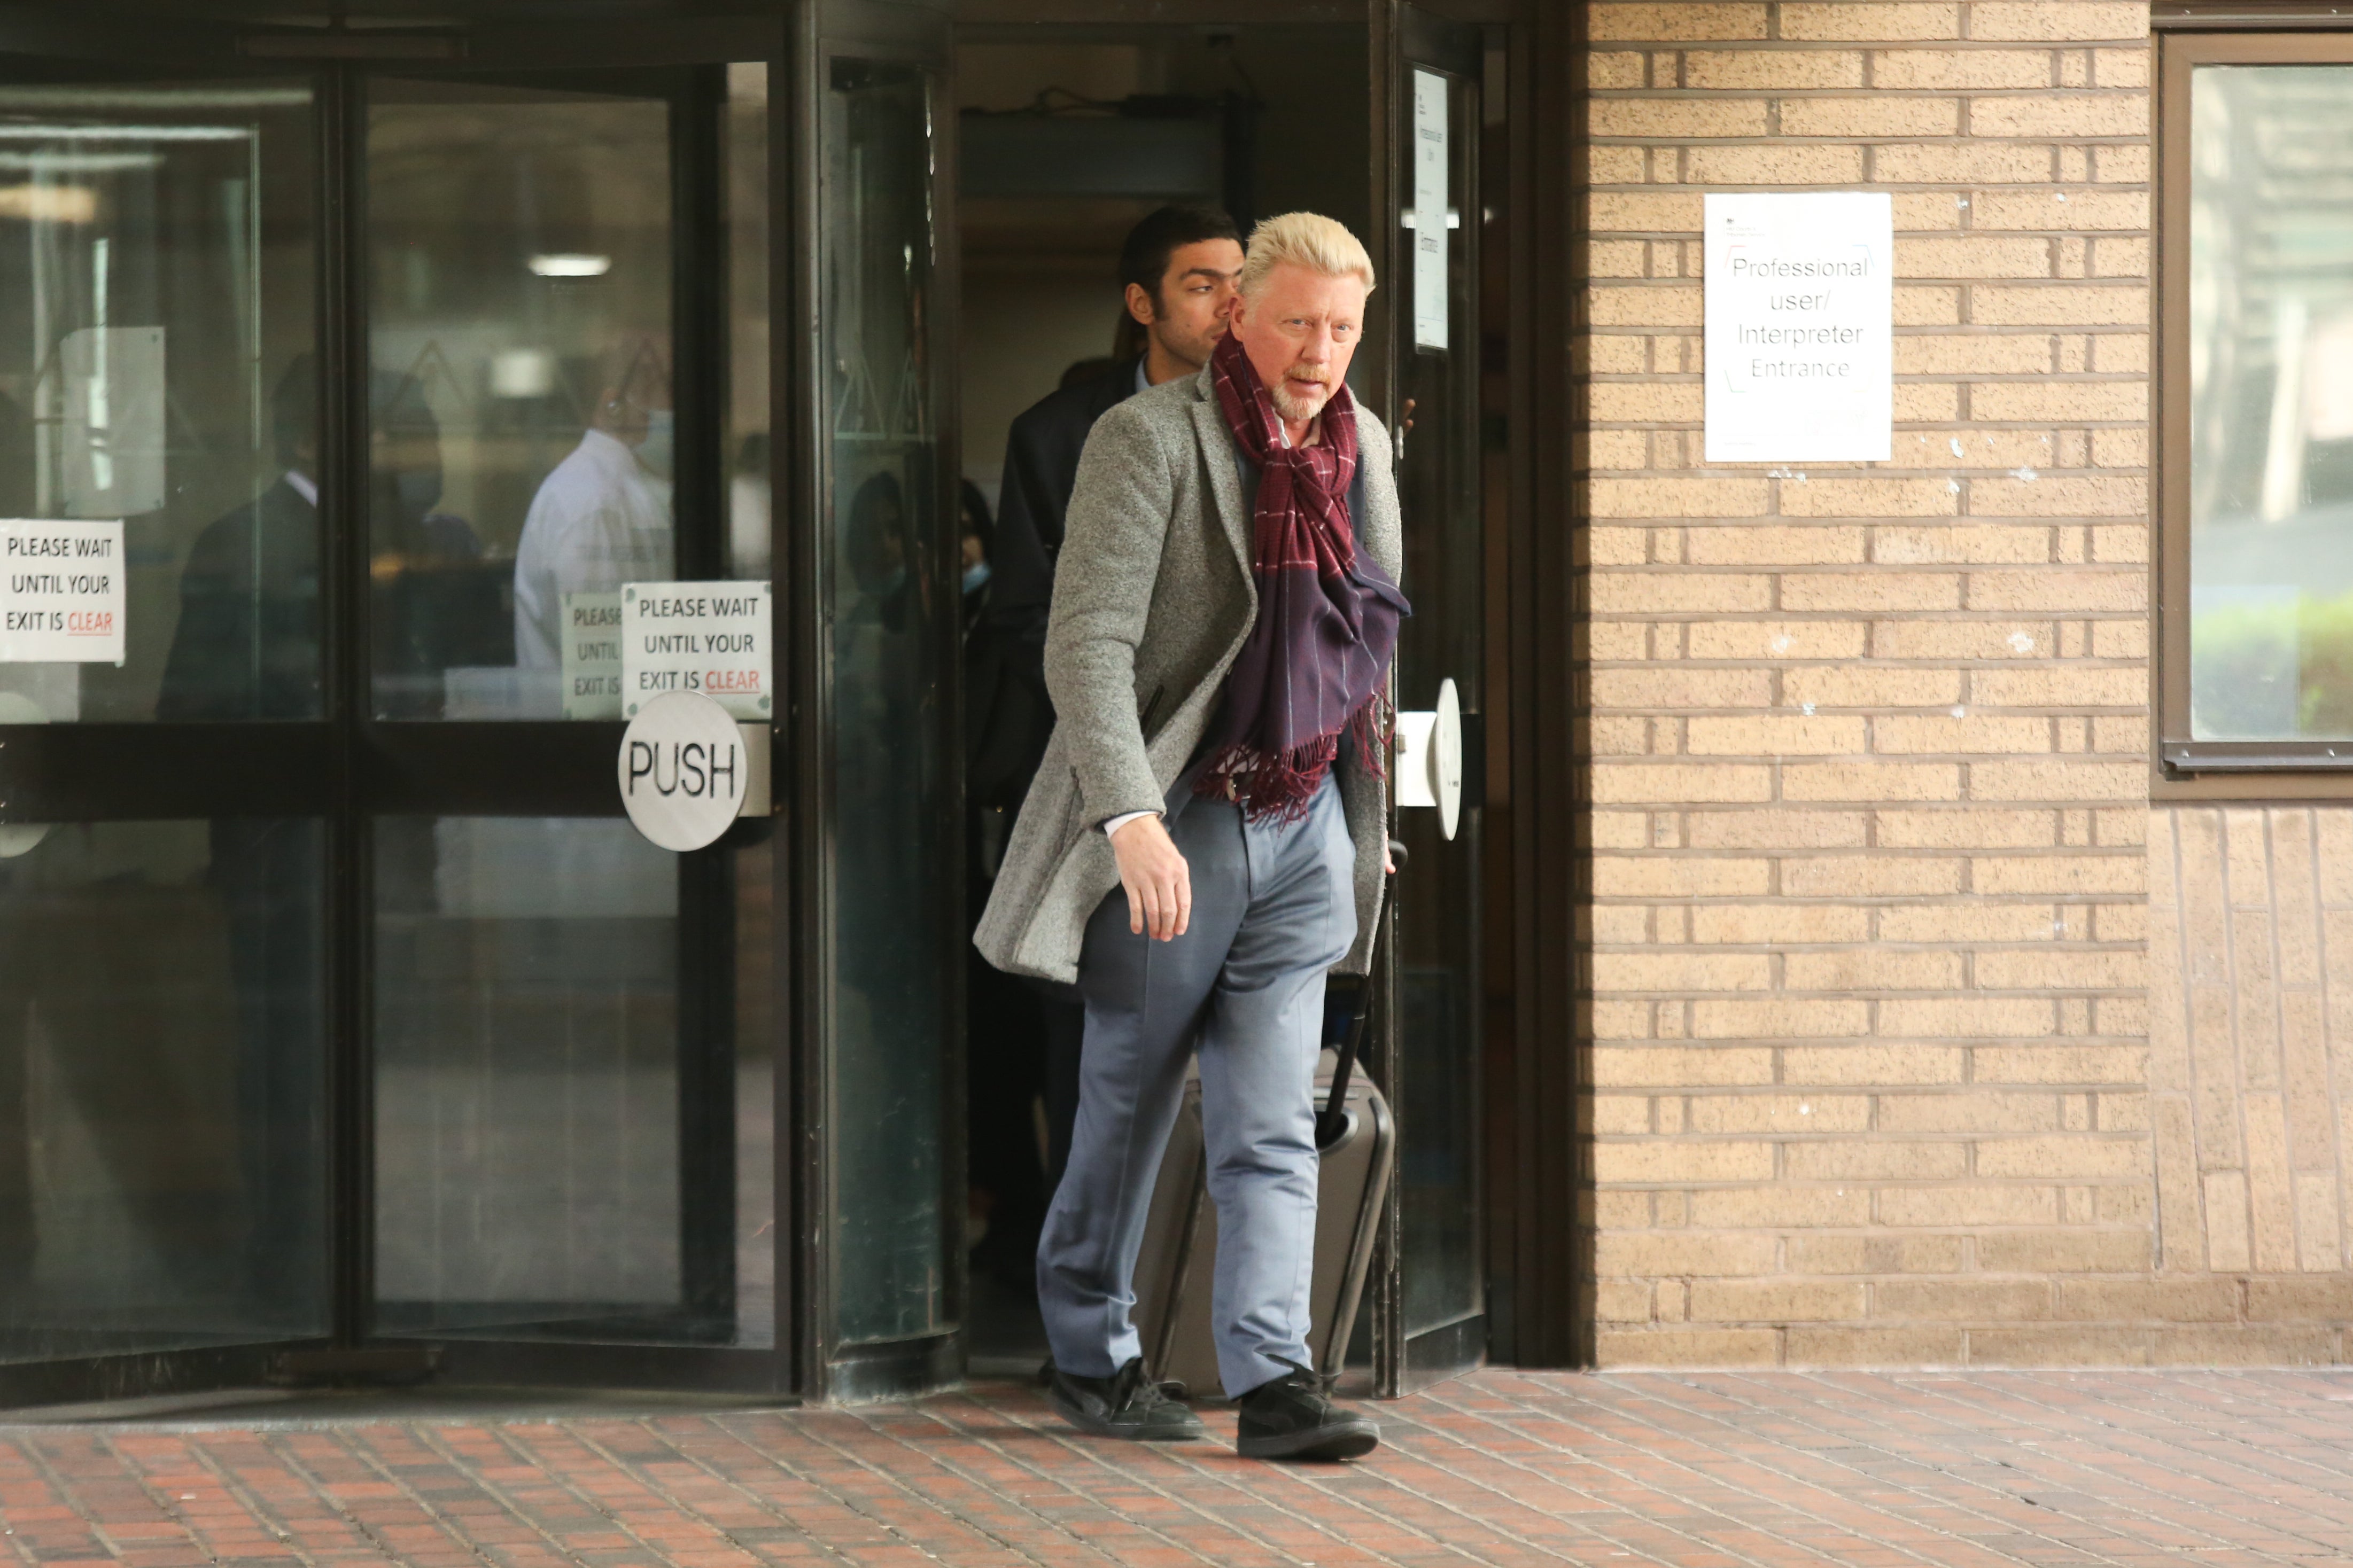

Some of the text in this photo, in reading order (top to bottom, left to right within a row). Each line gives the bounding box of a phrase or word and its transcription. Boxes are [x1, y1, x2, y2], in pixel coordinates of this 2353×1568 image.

[1734, 258, 1868, 277] Professional
[1770, 290, 1830, 310] user/
[1739, 324, 1863, 348] Interpreter
[1752, 359, 1850, 377] Entrance
[8, 537, 112, 557] PLEASE WAIT
[12, 575, 109, 595] UNTIL YOUR
[573, 607, 622, 626] PLEASE
[640, 598, 758, 617] PLEASE WAIT
[7, 612, 113, 631] EXIT IS CLEAR
[578, 642, 618, 661] UNTIL
[645, 635, 754, 653] UNTIL YOUR
[574, 676, 620, 696] EXIT IS
[640, 671, 759, 690] EXIT IS CLEAR
[628, 741, 734, 798] PUSH
